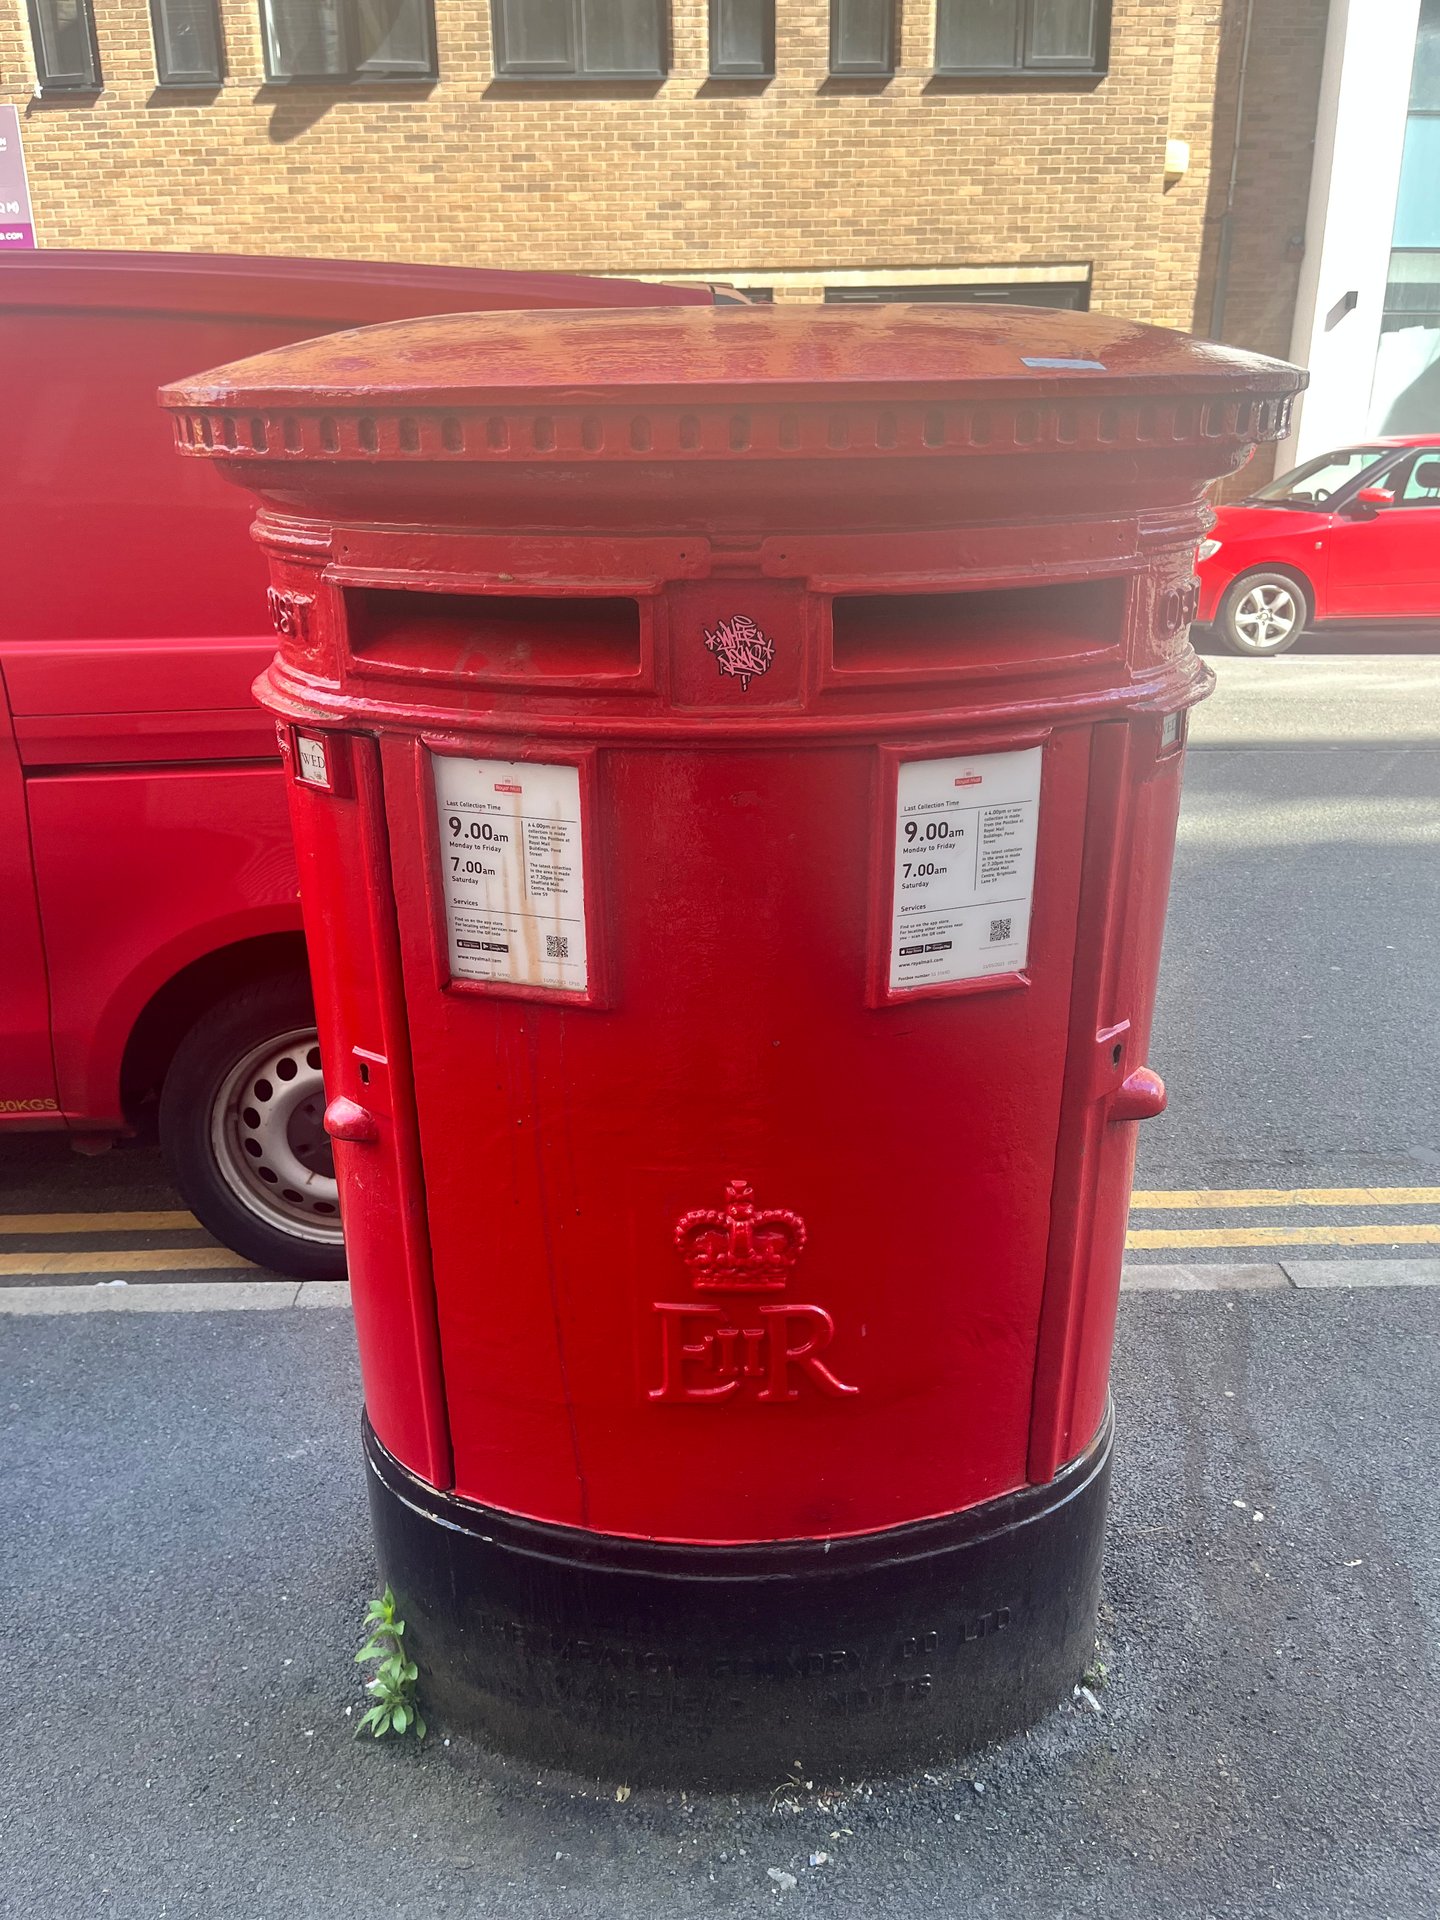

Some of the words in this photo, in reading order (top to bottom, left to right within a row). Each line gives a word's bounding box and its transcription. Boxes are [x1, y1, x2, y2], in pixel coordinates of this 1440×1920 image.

[301, 752, 326, 769] WED
[460, 801, 486, 809] Collection
[917, 802, 945, 810] Collection
[448, 816, 509, 842] 9.00am
[904, 821, 964, 843] 9.00am
[449, 841, 473, 851] Monday
[482, 844, 501, 853] Friday
[903, 845, 927, 854] Monday
[937, 842, 956, 850] Friday
[450, 856, 496, 876] 7.00am
[902, 862, 947, 878] 7.00am
[452, 876, 479, 885] Saturday
[902, 881, 929, 889] Saturday
[453, 898, 479, 907] Services
[900, 904, 927, 912] Services
[458, 955, 502, 963] www.royalmail.com
[899, 957, 944, 968] www.royalmail.com
